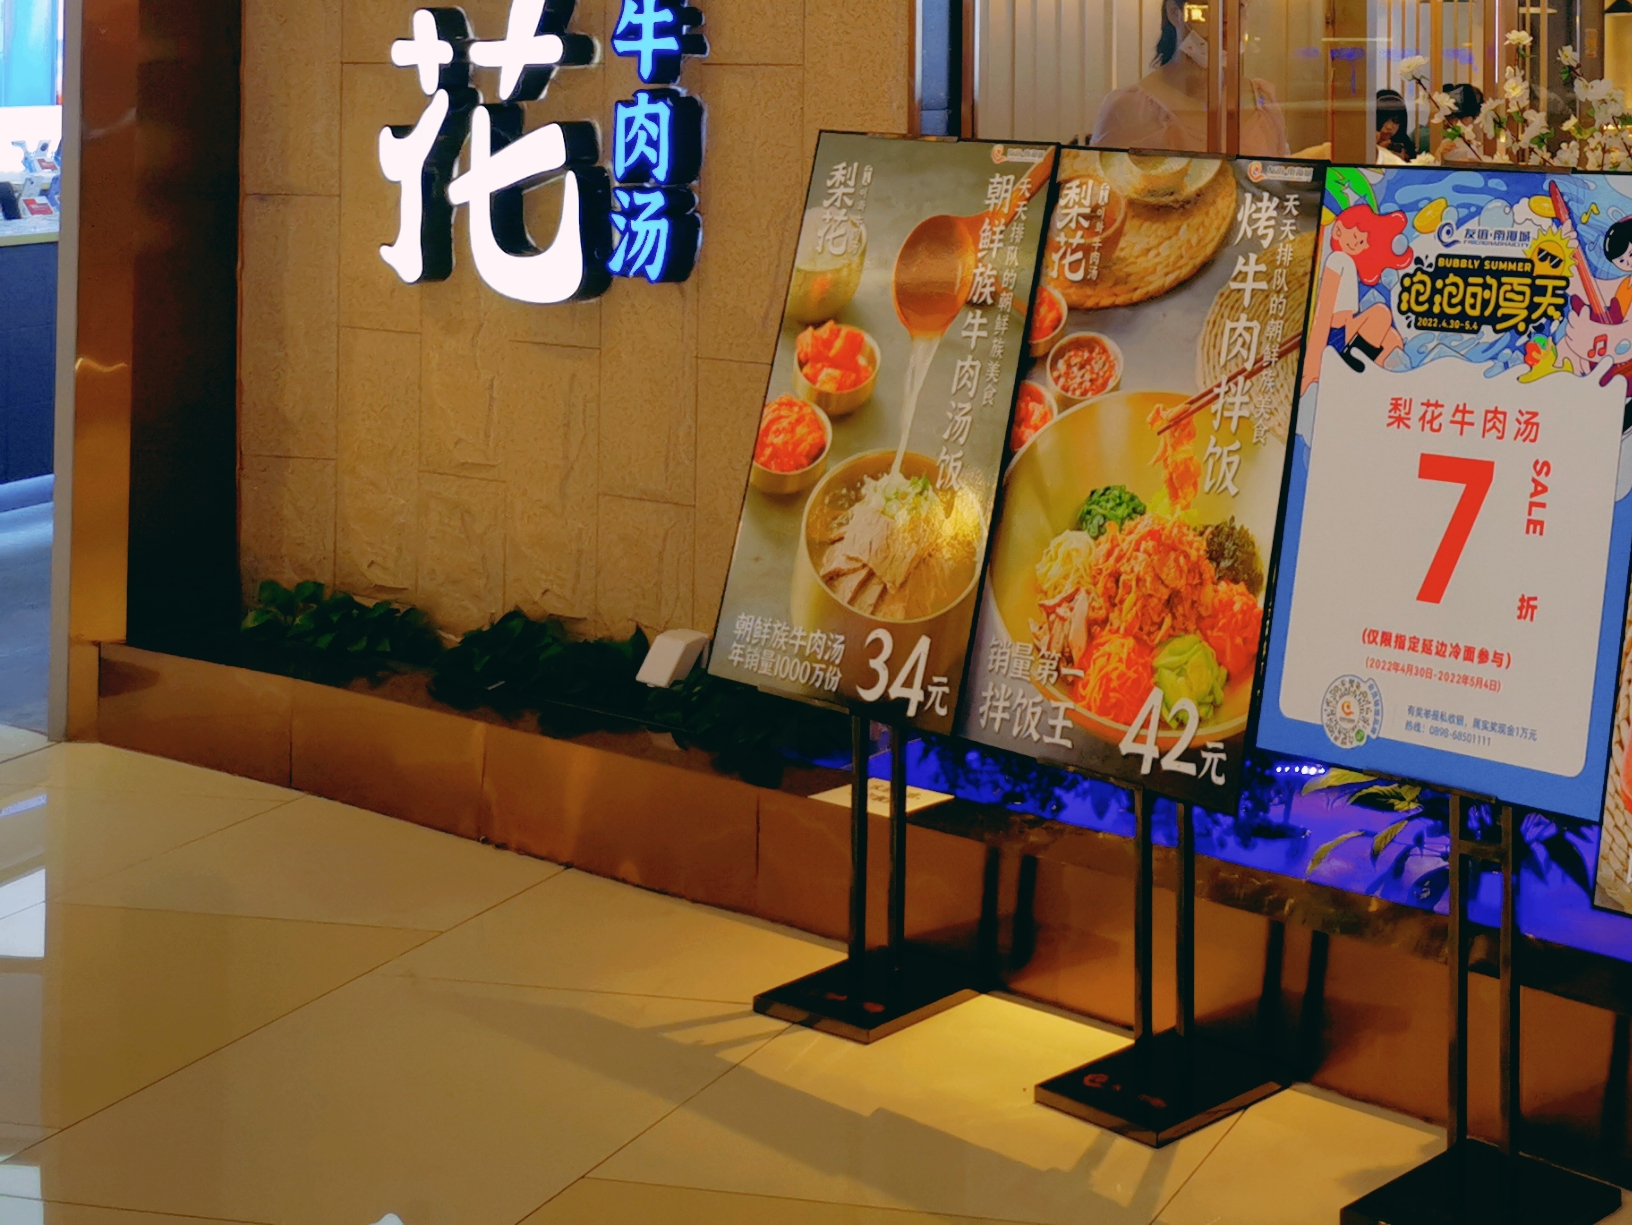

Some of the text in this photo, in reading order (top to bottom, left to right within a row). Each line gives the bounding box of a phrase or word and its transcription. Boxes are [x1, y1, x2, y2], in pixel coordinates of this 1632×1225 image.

[816, 161, 858, 256] 梨花
[1049, 179, 1094, 282] 梨花
[981, 177, 1032, 407] 天天排队的朝鲜族美食
[1400, 270, 1567, 333] 泡泡的夏天
[1437, 256, 1532, 272] BUBBLY SUMMER
[935, 172, 1016, 492] 朝鲜族牛肉汤饭
[1203, 190, 1280, 498] 烤牛肉拌饭
[1252, 193, 1300, 445] 天天排队的朝鲜族美食
[1416, 316, 1479, 331] 2022.4.30-5.4
[1386, 396, 1541, 444] 梨花牛肉汤
[1416, 452, 1496, 605] 7
[1525, 458, 1552, 537] SALE
[734, 612, 846, 665] 朝鲜族牛肉汤
[1516, 593, 1539, 623] 折
[728, 641, 843, 693] 年销量1000万份
[855, 627, 950, 718] 34元
[987, 637, 1085, 686] 销量第一
[979, 681, 1076, 749] 拌饭王
[1119, 685, 1228, 786] 42元
